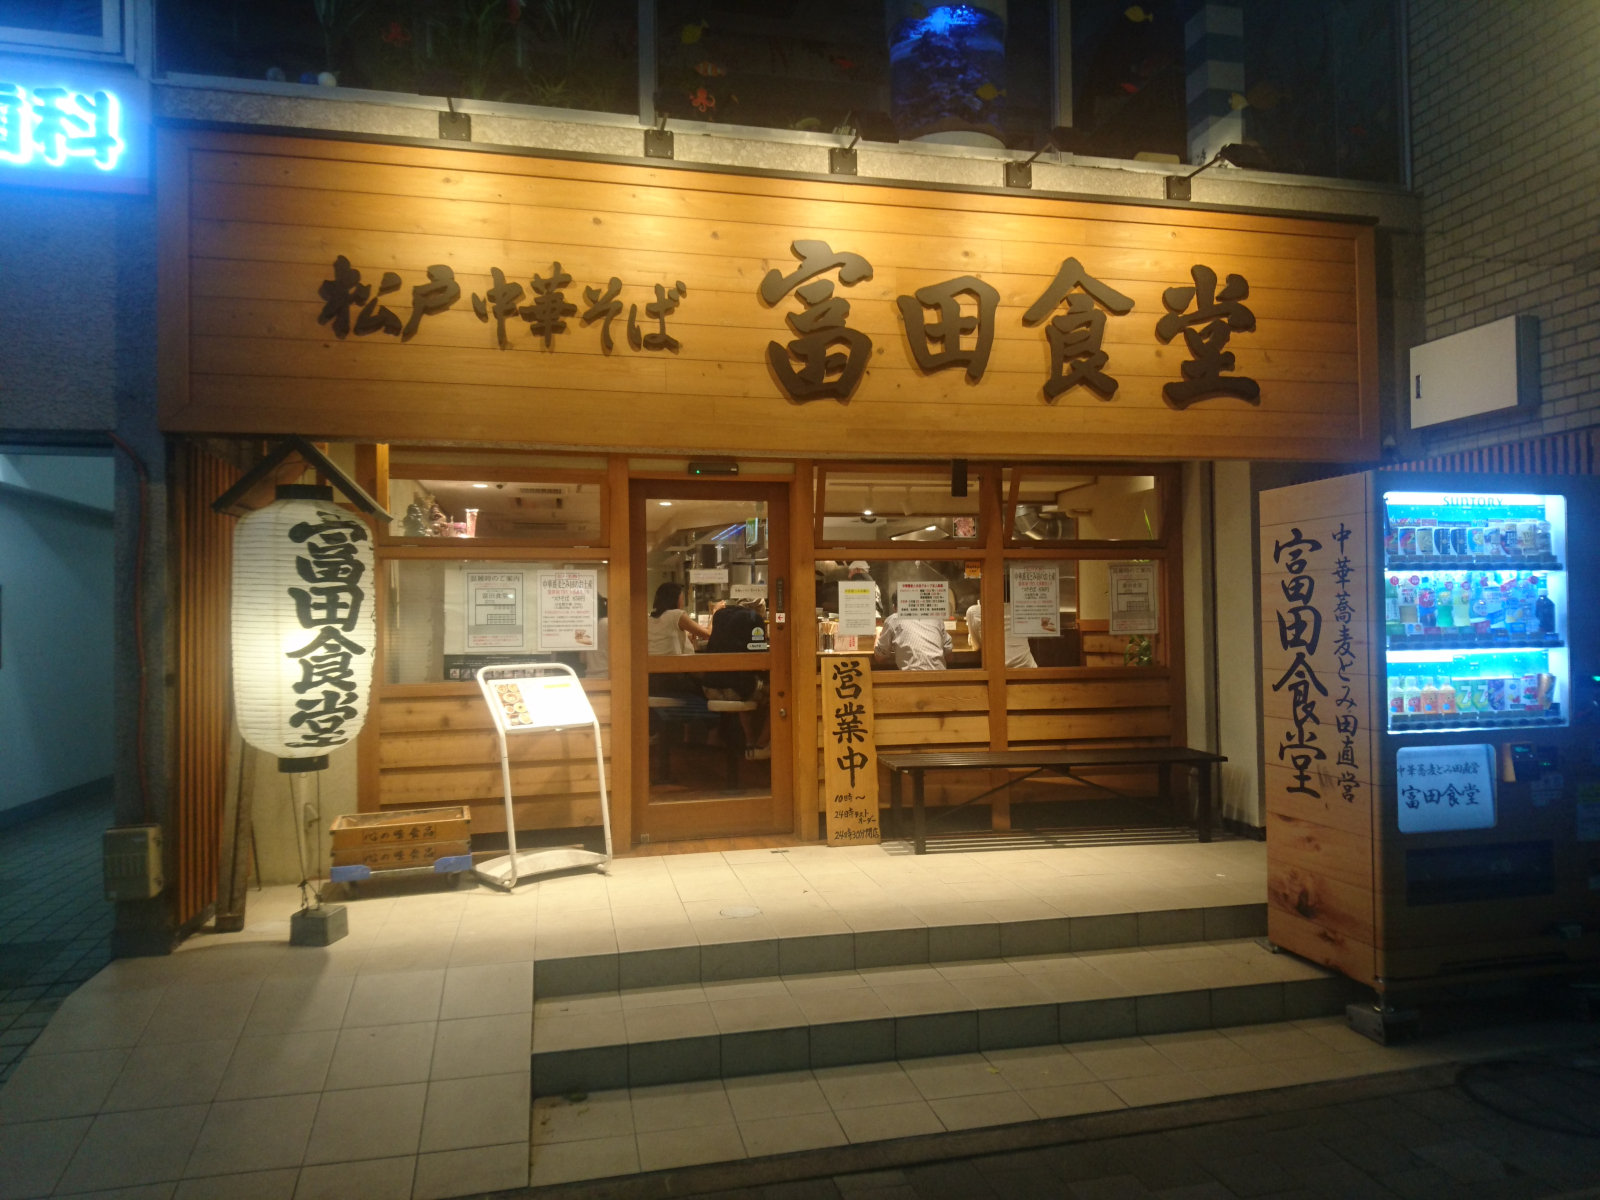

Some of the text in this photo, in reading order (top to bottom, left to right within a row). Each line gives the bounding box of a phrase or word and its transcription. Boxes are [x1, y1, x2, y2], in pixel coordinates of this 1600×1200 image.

[317, 254, 687, 353] 松戸中華そば
[761, 239, 1260, 410] 富田食堂
[284, 510, 368, 749] 富田食堂
[1272, 527, 1329, 799] 富田食堂
[1331, 522, 1361, 804] 中華蕎麦とみ田直営
[832, 660, 869, 789] 営業中
[1397, 761, 1480, 777] 中華蕎麦とみ田直営
[364, 825, 435, 842] 心の味食品
[1401, 783, 1480, 809] 富田食堂
[364, 847, 435, 863] 心の味食品
